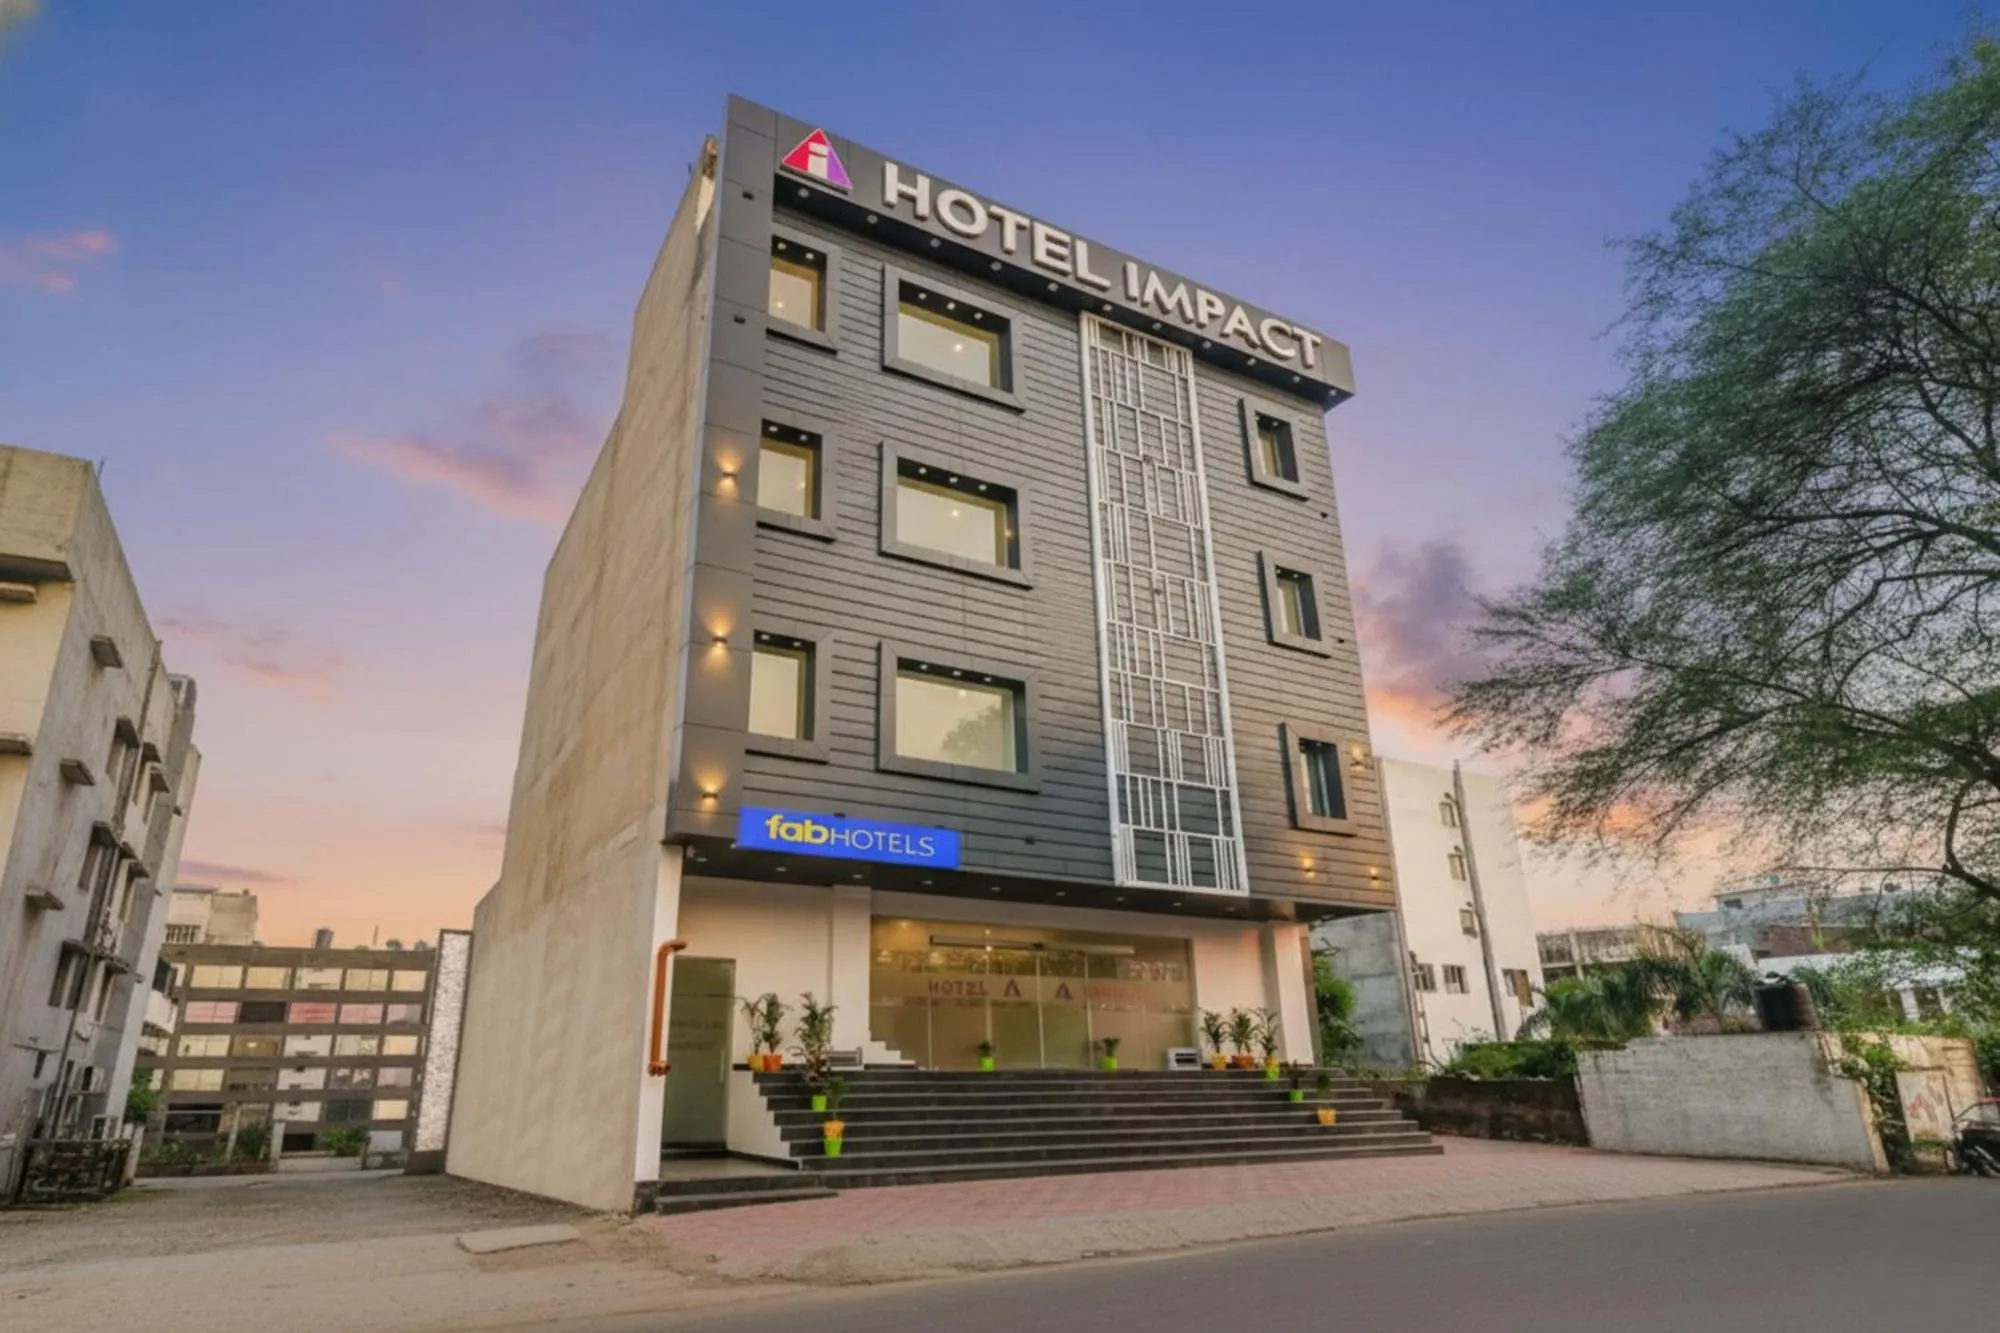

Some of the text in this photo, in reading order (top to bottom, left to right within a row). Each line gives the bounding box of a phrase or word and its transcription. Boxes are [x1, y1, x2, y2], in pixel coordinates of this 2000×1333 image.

[883, 160, 1323, 369] HOTEL IMPACT
[765, 814, 935, 857] fabHOTELS
[928, 980, 988, 997] HOTEL
